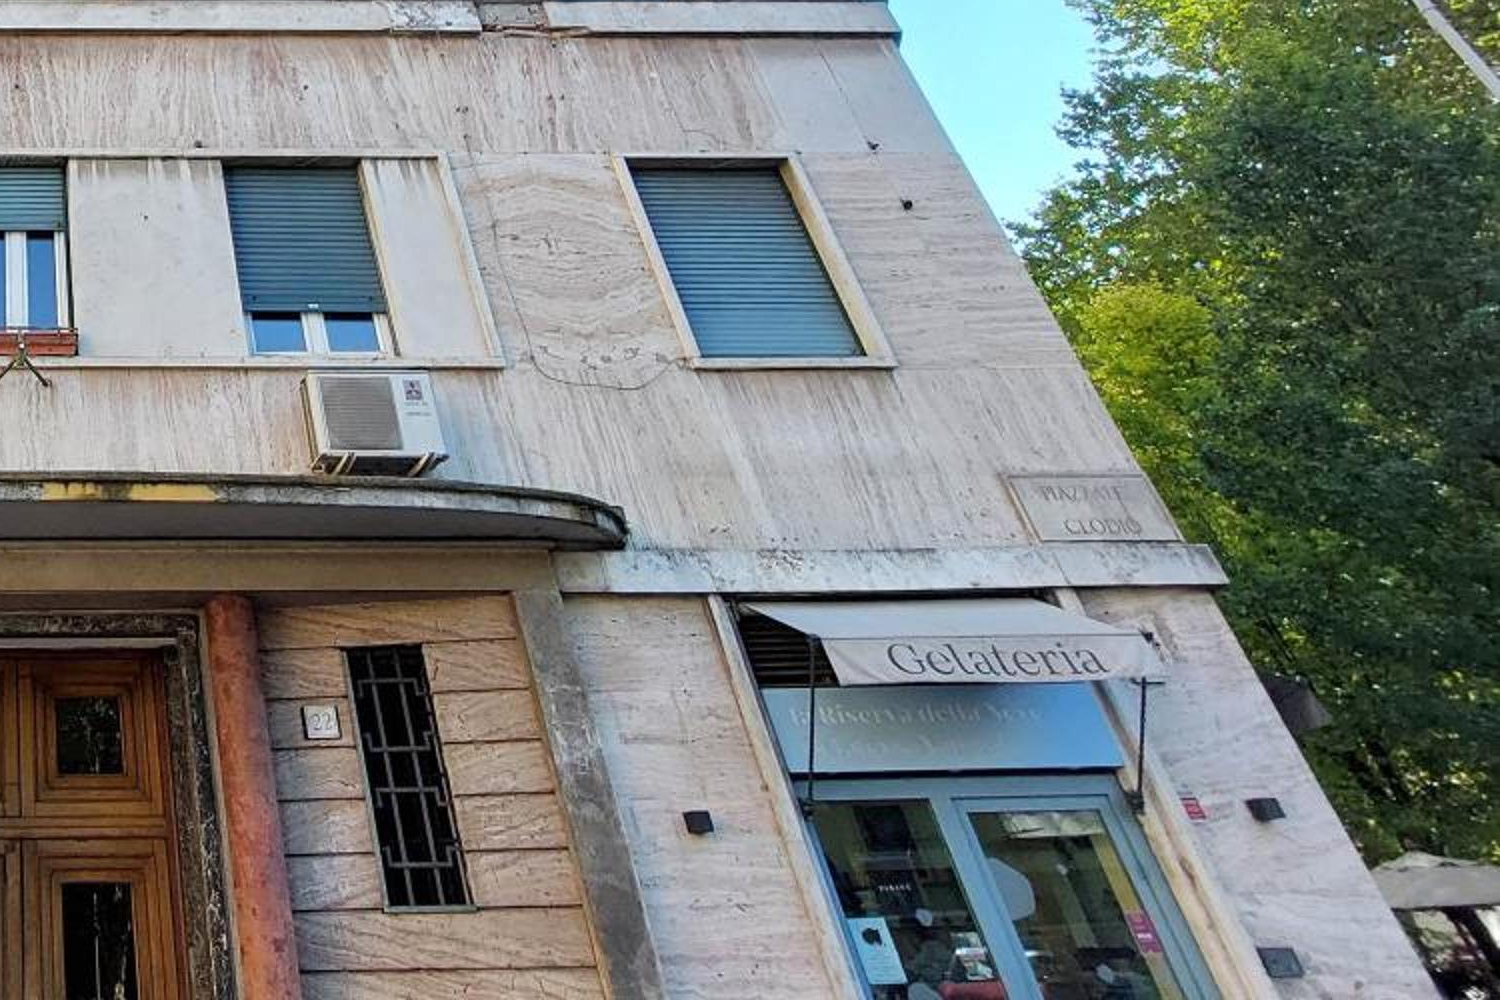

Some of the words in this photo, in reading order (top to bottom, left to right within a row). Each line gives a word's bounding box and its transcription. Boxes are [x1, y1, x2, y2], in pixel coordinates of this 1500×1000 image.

[1063, 519, 1143, 536] CLODIO
[886, 641, 1109, 677] Gelateria
[311, 712, 333, 731] 22
